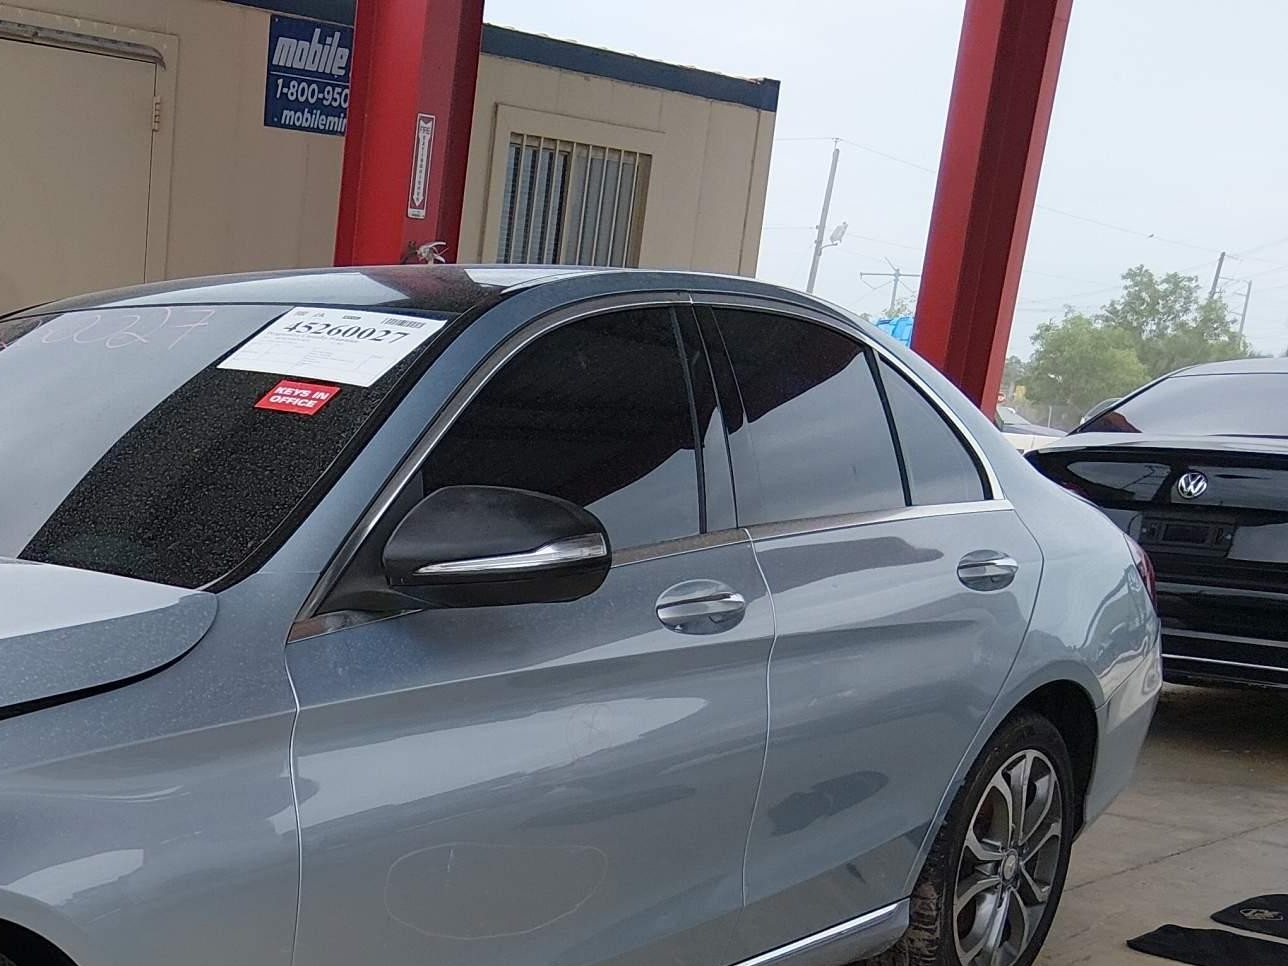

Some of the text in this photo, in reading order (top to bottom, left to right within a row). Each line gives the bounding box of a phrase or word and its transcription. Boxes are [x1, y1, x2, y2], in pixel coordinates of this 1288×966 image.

[272, 28, 349, 75] mobile
[283, 321, 409, 343] 45260027
[268, 395, 318, 409] OFFICE
[274, 387, 330, 400] KEYS IN
